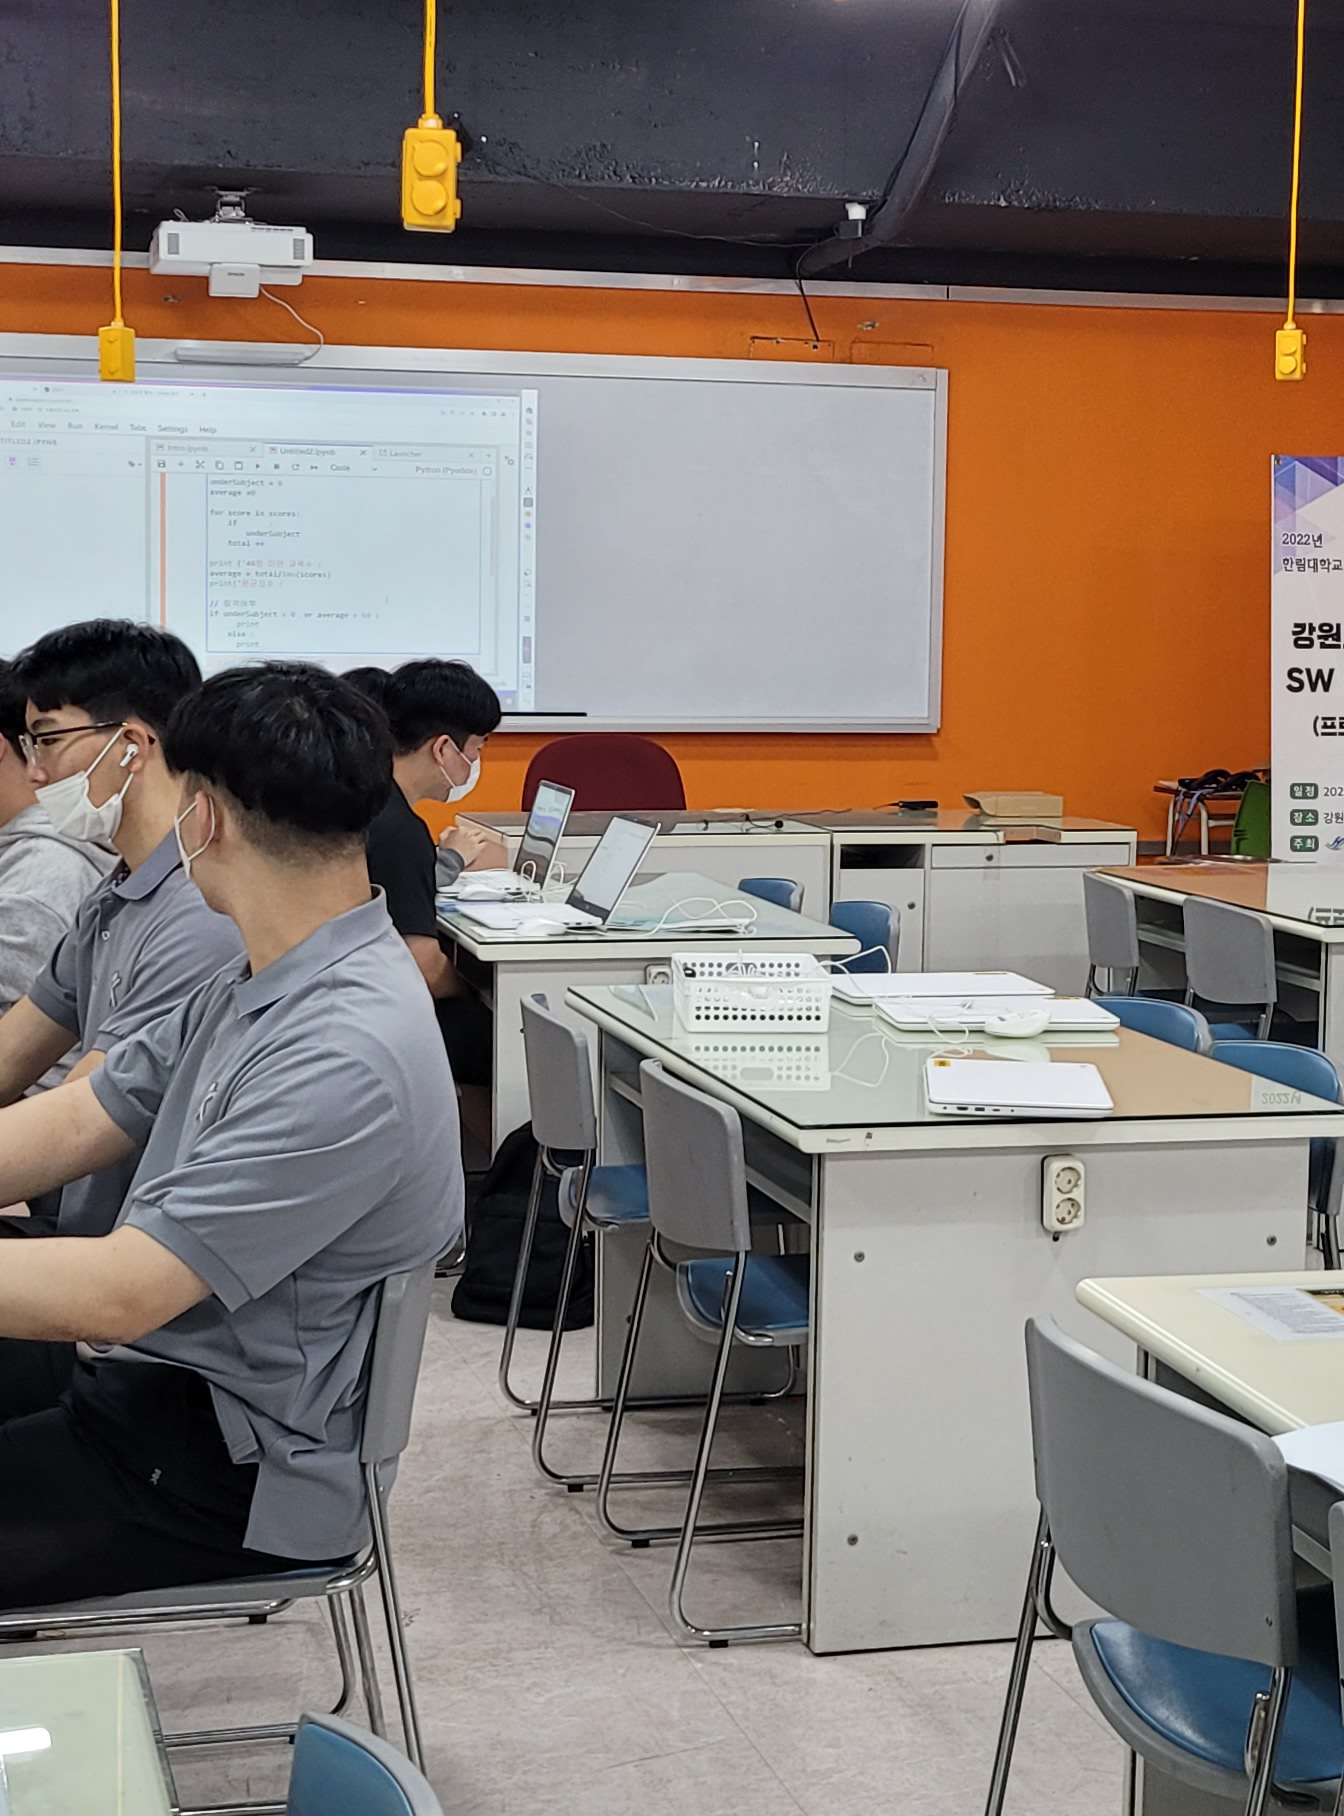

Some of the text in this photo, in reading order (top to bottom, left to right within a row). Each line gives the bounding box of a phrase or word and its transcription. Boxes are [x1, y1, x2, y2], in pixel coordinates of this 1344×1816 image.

[11, 420, 26, 428] Edit
[68, 422, 83, 430] Run
[130, 424, 146, 432] Tabs
[158, 425, 188, 434] Settings
[200, 426, 216, 434] Help
[280, 448, 336, 456] Untitled2.ipynb
[416, 466, 441, 475] Python
[1282, 533, 1323, 548] 2022년
[1282, 557, 1343, 572] 한림대학교
[1286, 666, 1335, 693] SW
[1293, 786, 1315, 797] 일정
[1293, 812, 1316, 823] 장소
